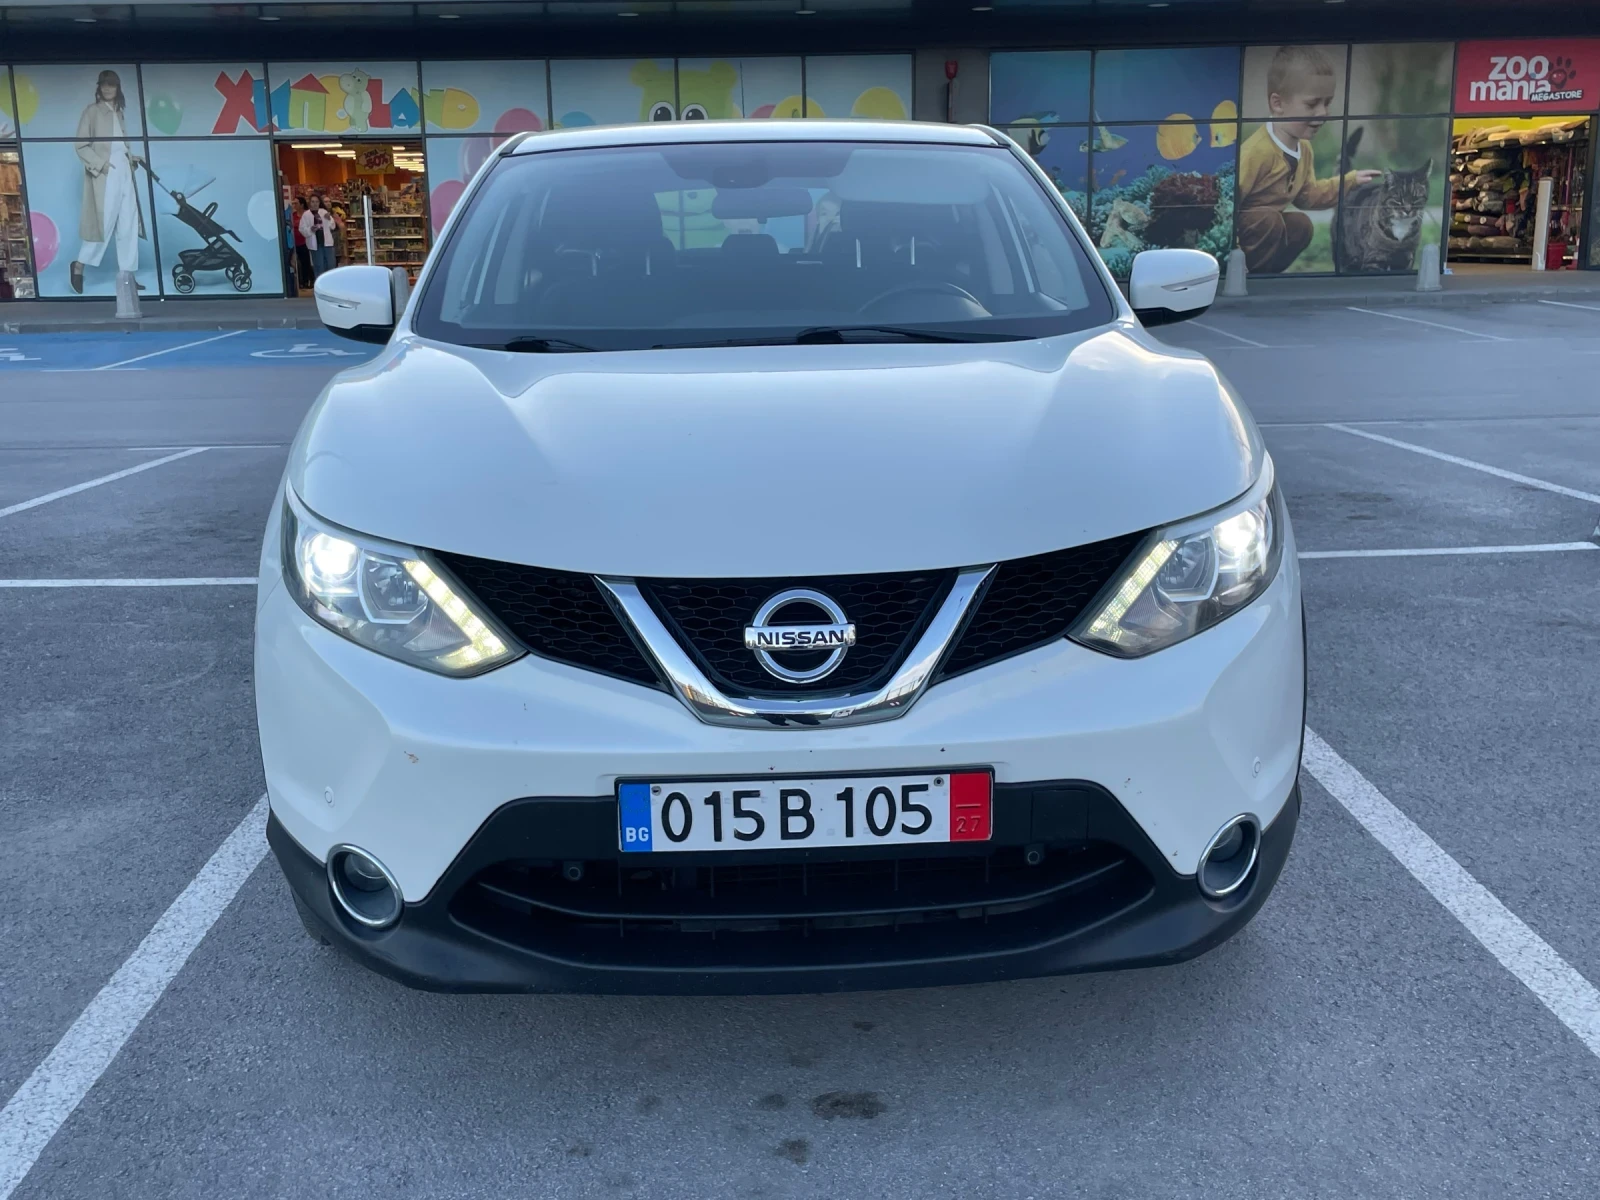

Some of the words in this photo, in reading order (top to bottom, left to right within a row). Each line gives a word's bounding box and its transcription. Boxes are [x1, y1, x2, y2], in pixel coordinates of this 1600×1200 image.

[1469, 80, 1551, 101] mania
[1530, 90, 1582, 102] MEGASTORE
[757, 630, 844, 646] NISSAN
[956, 815, 981, 833] 27
[625, 827, 649, 842] BG
